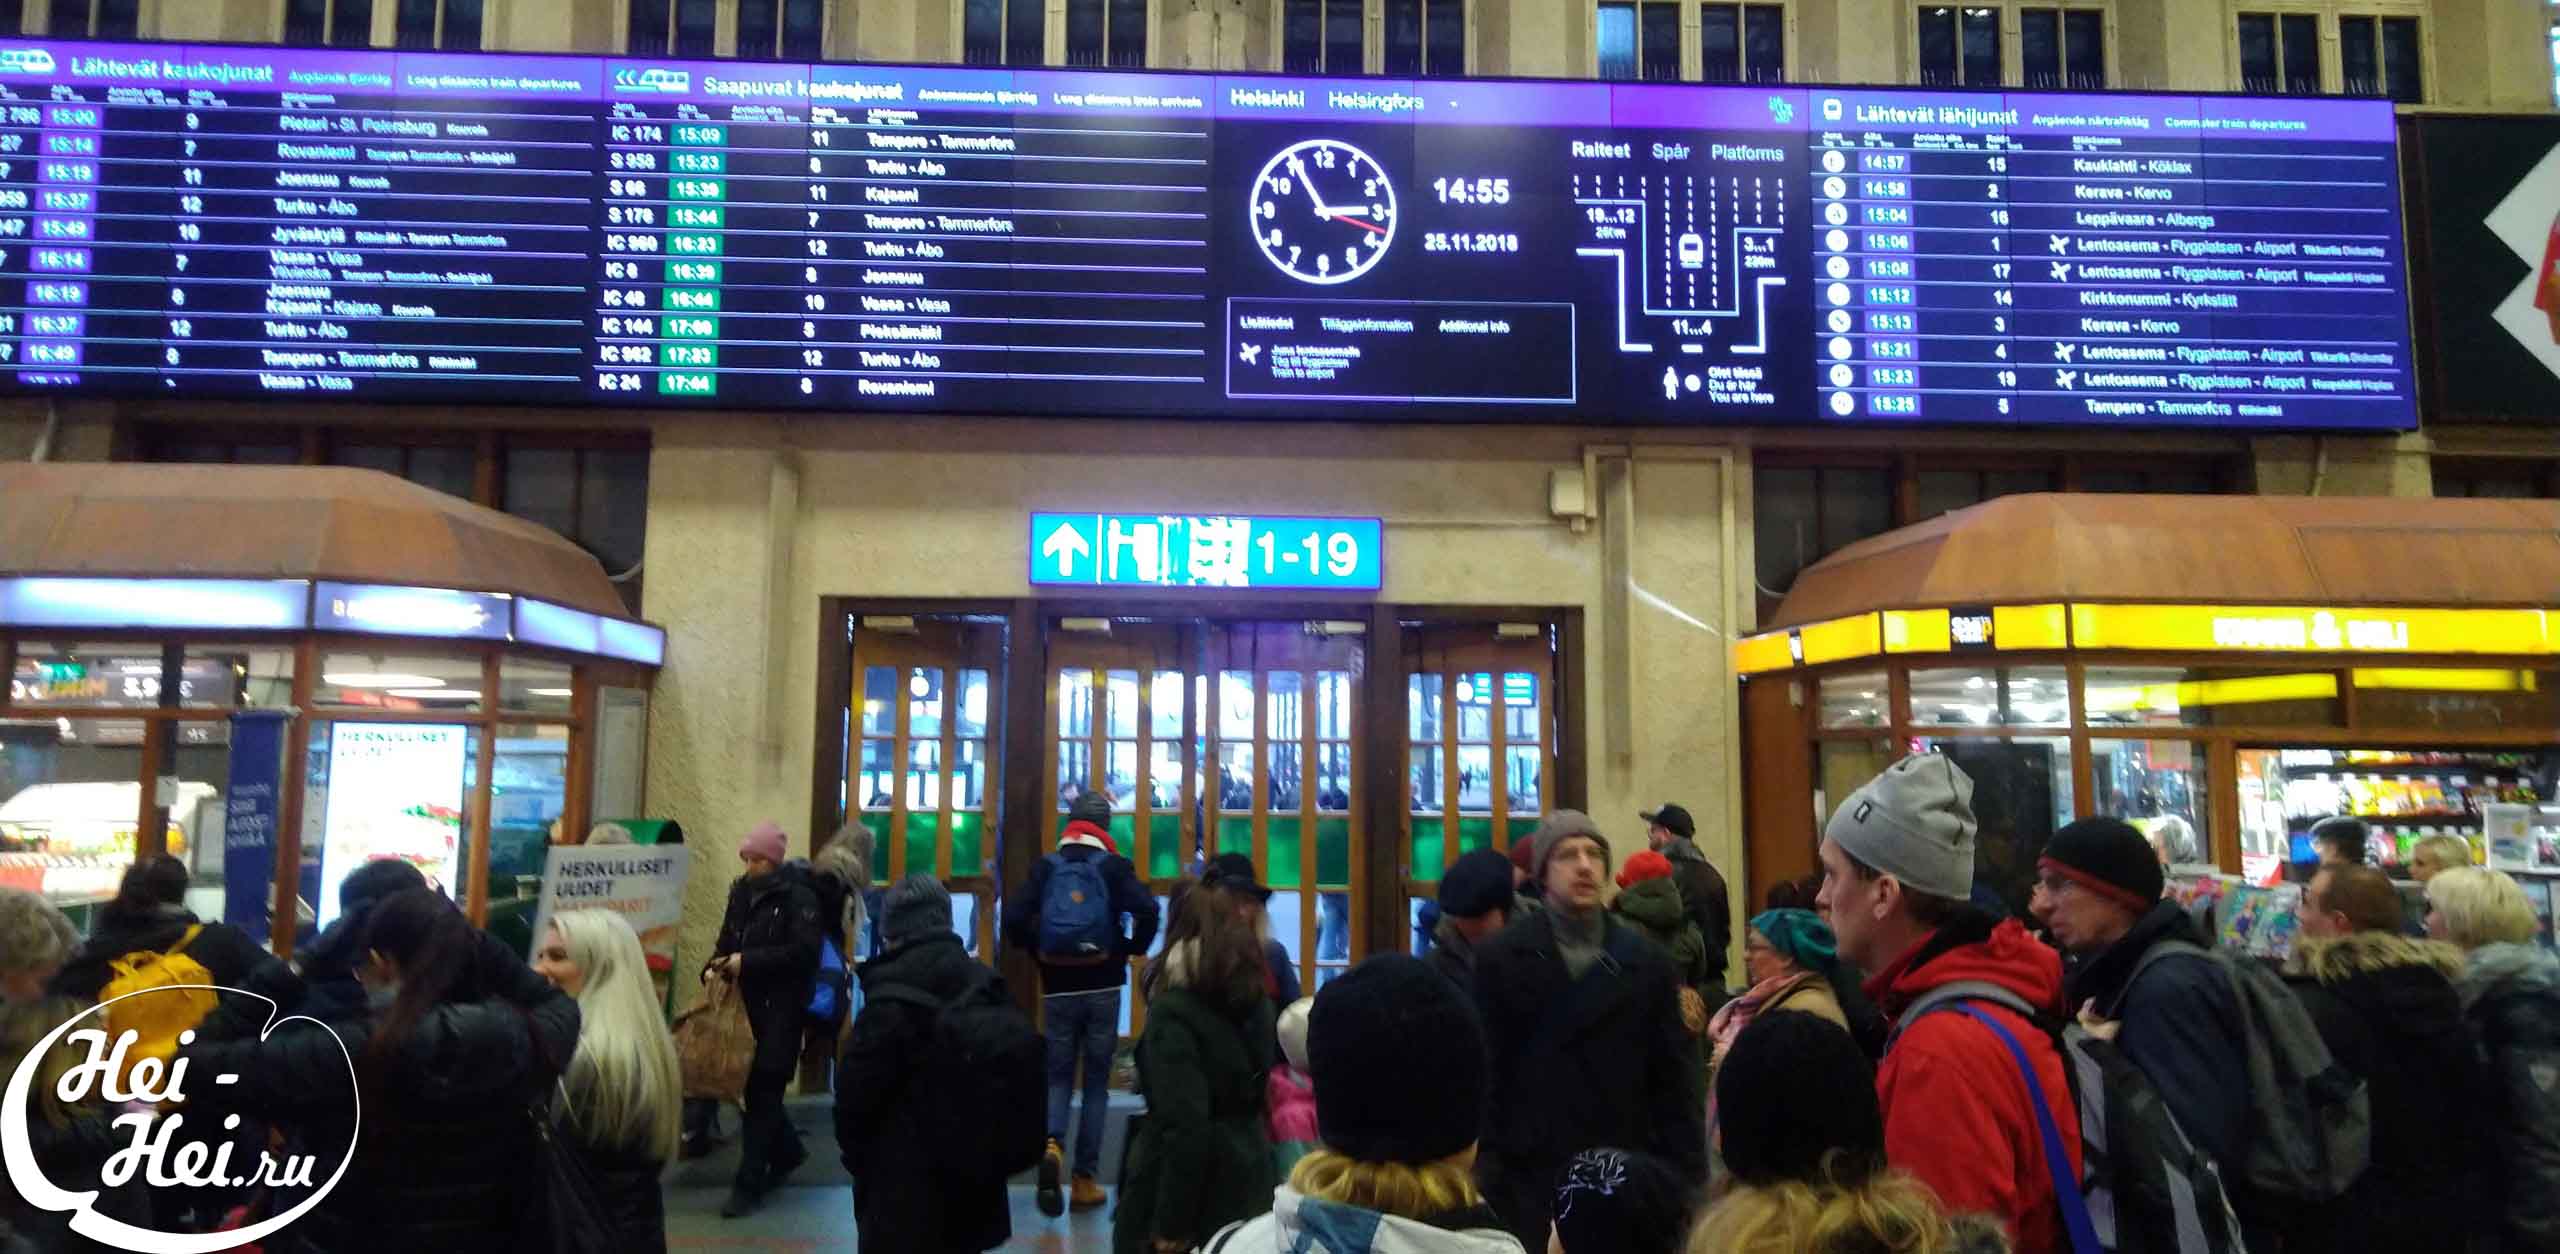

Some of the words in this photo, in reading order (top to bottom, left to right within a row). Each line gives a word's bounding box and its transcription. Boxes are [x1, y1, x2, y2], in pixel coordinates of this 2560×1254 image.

[704, 76, 792, 98] Saapuvat
[1231, 89, 1305, 108] Helsinki
[1329, 91, 1424, 112] Helsingfors
[1857, 105, 1936, 123] Lähtevät
[1939, 107, 2018, 127] lähijunat
[679, 127, 720, 142] 15:09
[1313, 150, 1335, 168] 12
[1572, 141, 1631, 159] Raiteet
[1652, 143, 1690, 162] Spår
[1711, 144, 1784, 162] Platforms
[1433, 178, 1510, 204] 14:55
[1256, 530, 1359, 577] 1-19
